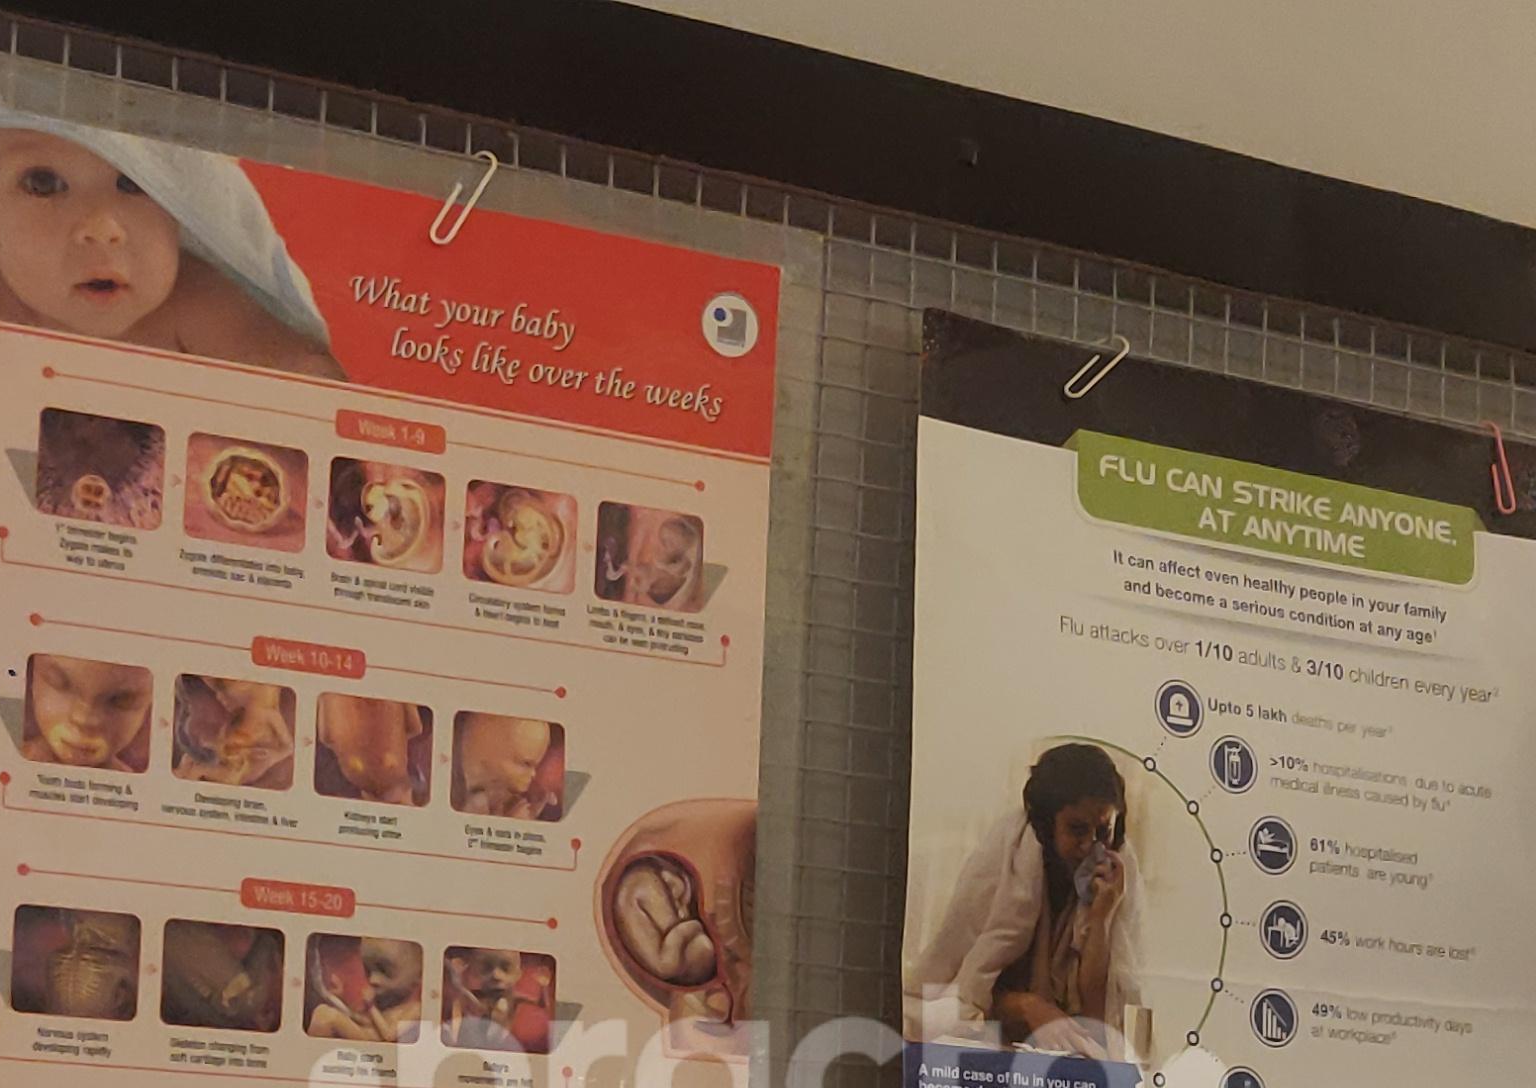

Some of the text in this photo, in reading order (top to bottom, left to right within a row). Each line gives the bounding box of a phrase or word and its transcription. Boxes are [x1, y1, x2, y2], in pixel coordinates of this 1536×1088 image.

[349, 274, 576, 350] What your baby
[391, 327, 724, 419] looks like over the weeks
[1100, 455, 1156, 485] FLU
[1167, 468, 1222, 498] CAN
[1233, 481, 1331, 519] STRIKE
[1198, 507, 1365, 558] AT ANYTIME
[1113, 549, 1447, 625] It can affect even healthy people in your family
[265, 644, 354, 673] Week 10-14
[1060, 616, 1409, 690] Flu attacks over 1/10 adults & 3/10 children
[1207, 698, 1286, 722] Upto 5 lakh
[253, 886, 343, 911] Week 15-20
[1320, 929, 1350, 946] 45%
[1312, 1003, 1342, 1020] 49%
